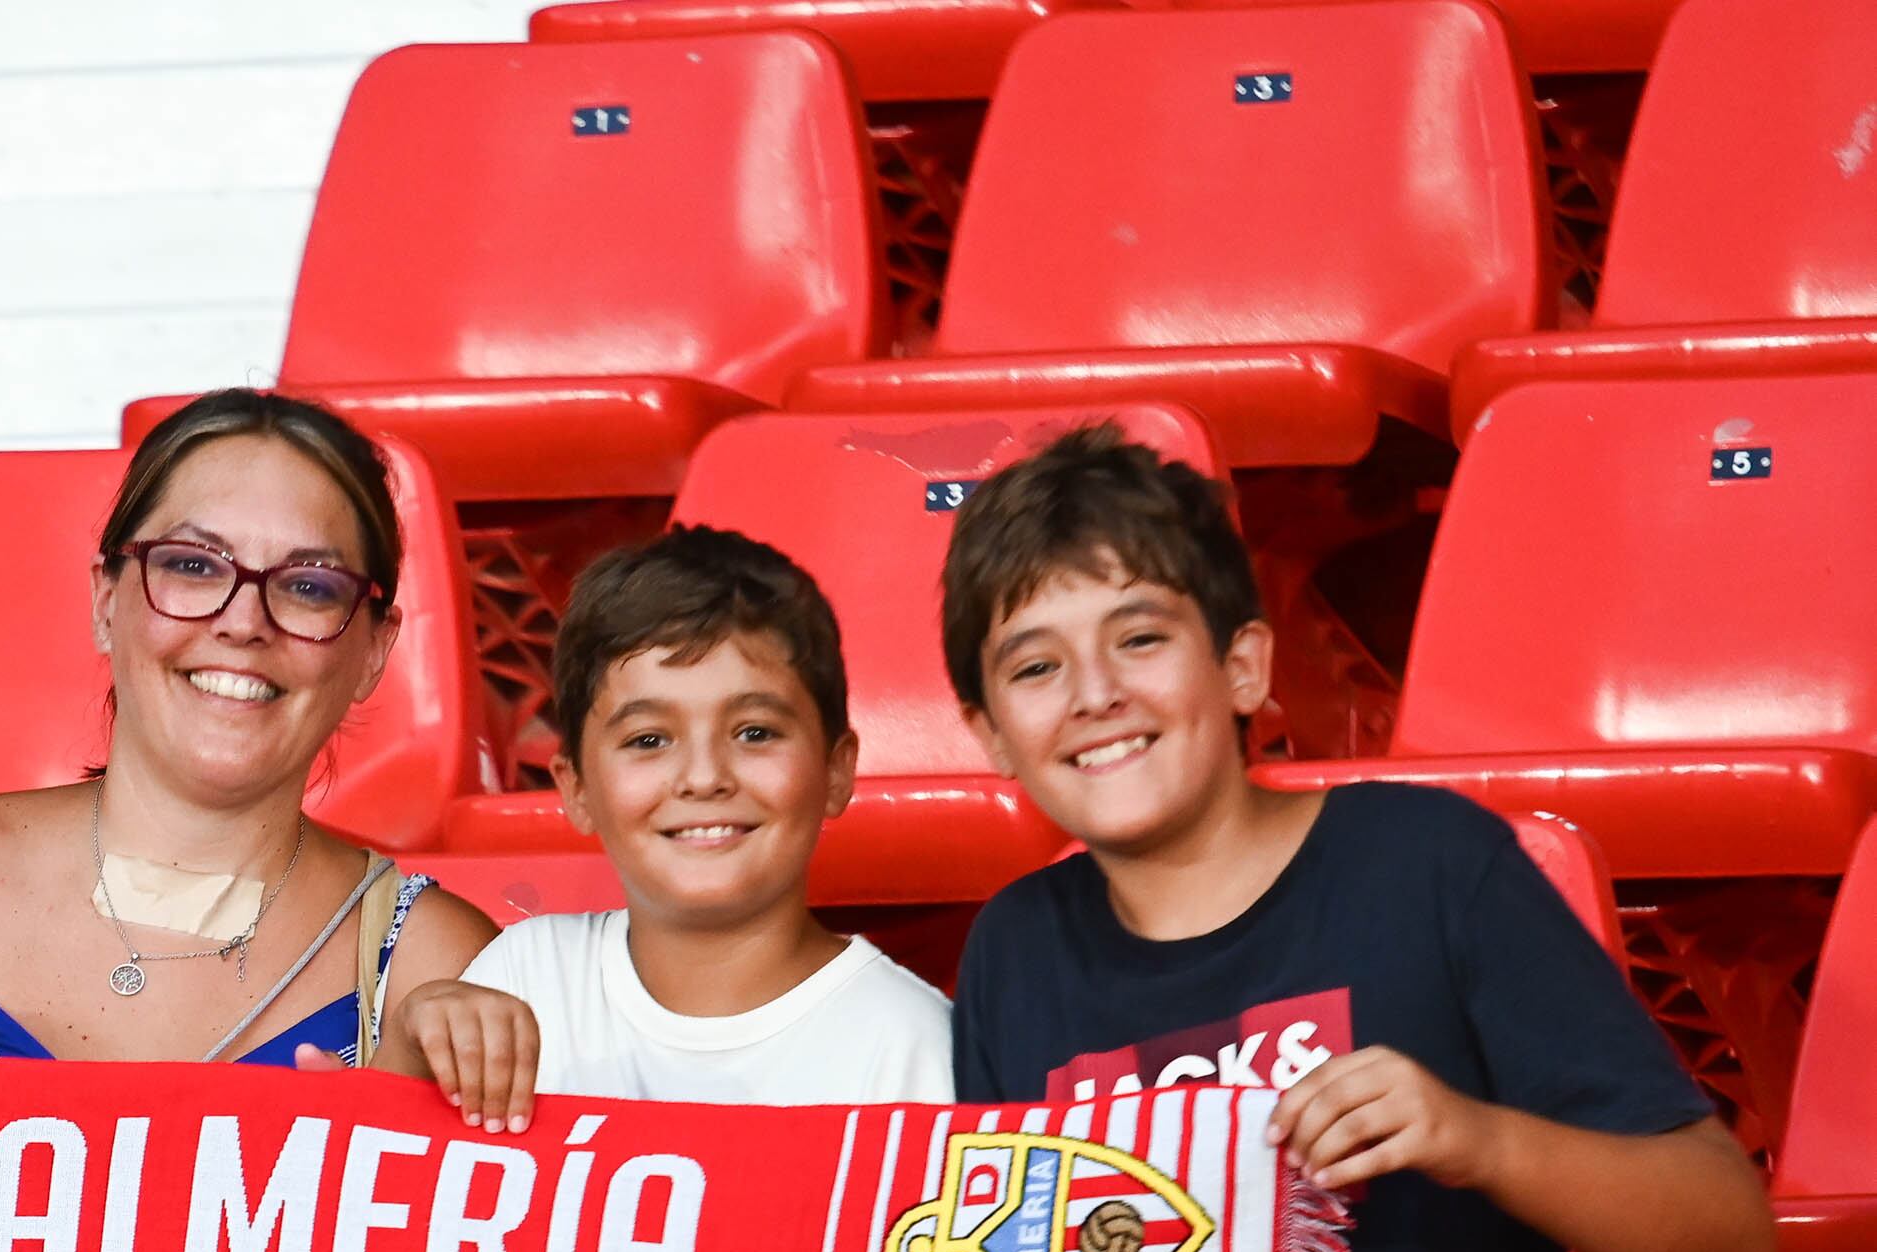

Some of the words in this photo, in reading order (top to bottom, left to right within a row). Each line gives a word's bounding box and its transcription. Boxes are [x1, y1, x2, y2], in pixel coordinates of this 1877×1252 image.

[1253, 76, 1273, 100] 3
[595, 109, 608, 132] 1
[1732, 451, 1751, 475] 5
[945, 483, 964, 507] 3
